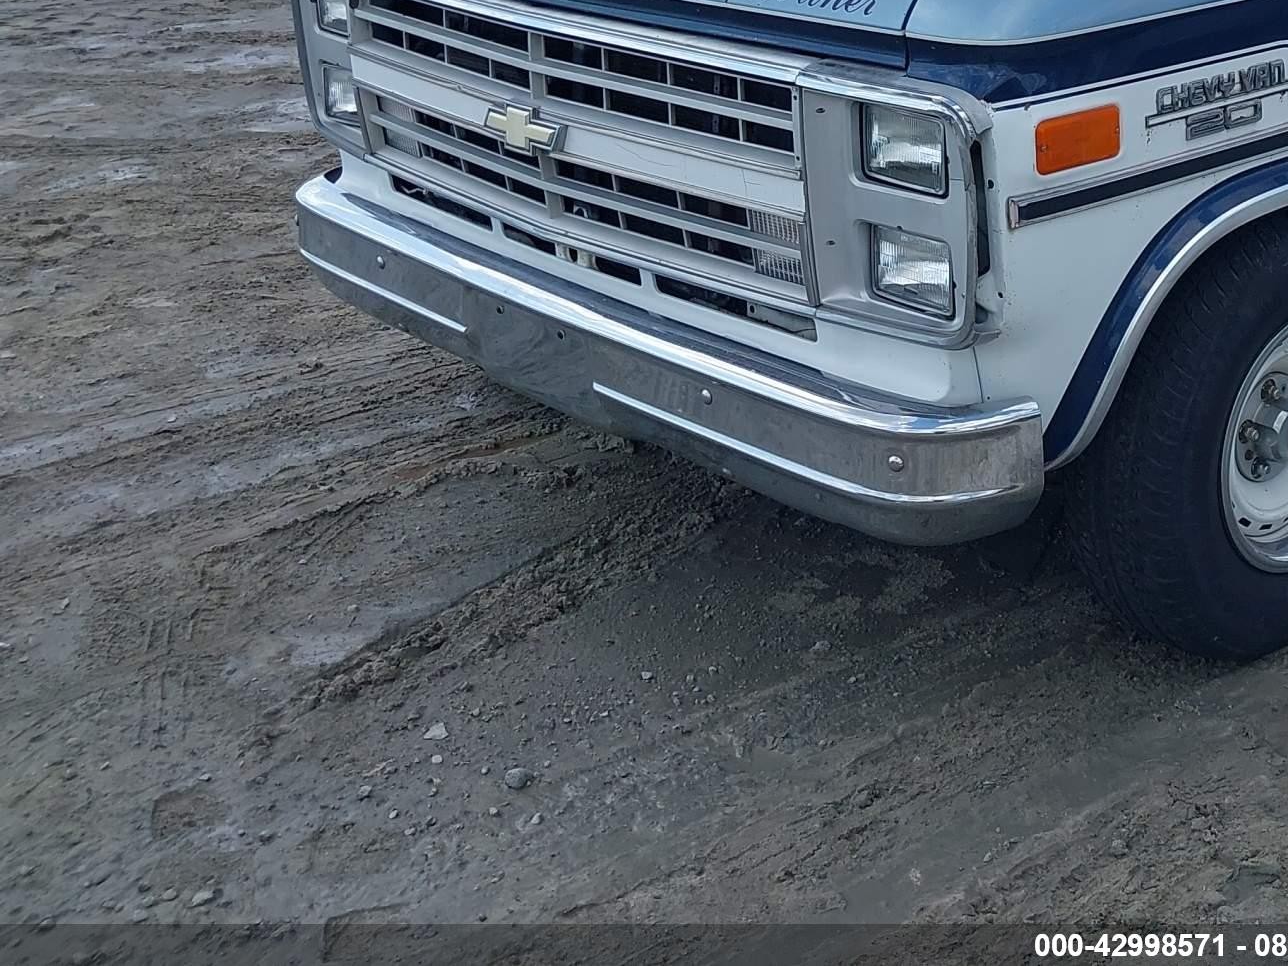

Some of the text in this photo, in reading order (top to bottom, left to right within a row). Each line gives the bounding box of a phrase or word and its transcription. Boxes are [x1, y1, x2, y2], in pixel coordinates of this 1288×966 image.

[1156, 58, 1286, 114] CHEVY VAN
[1185, 98, 1263, 142] 20
